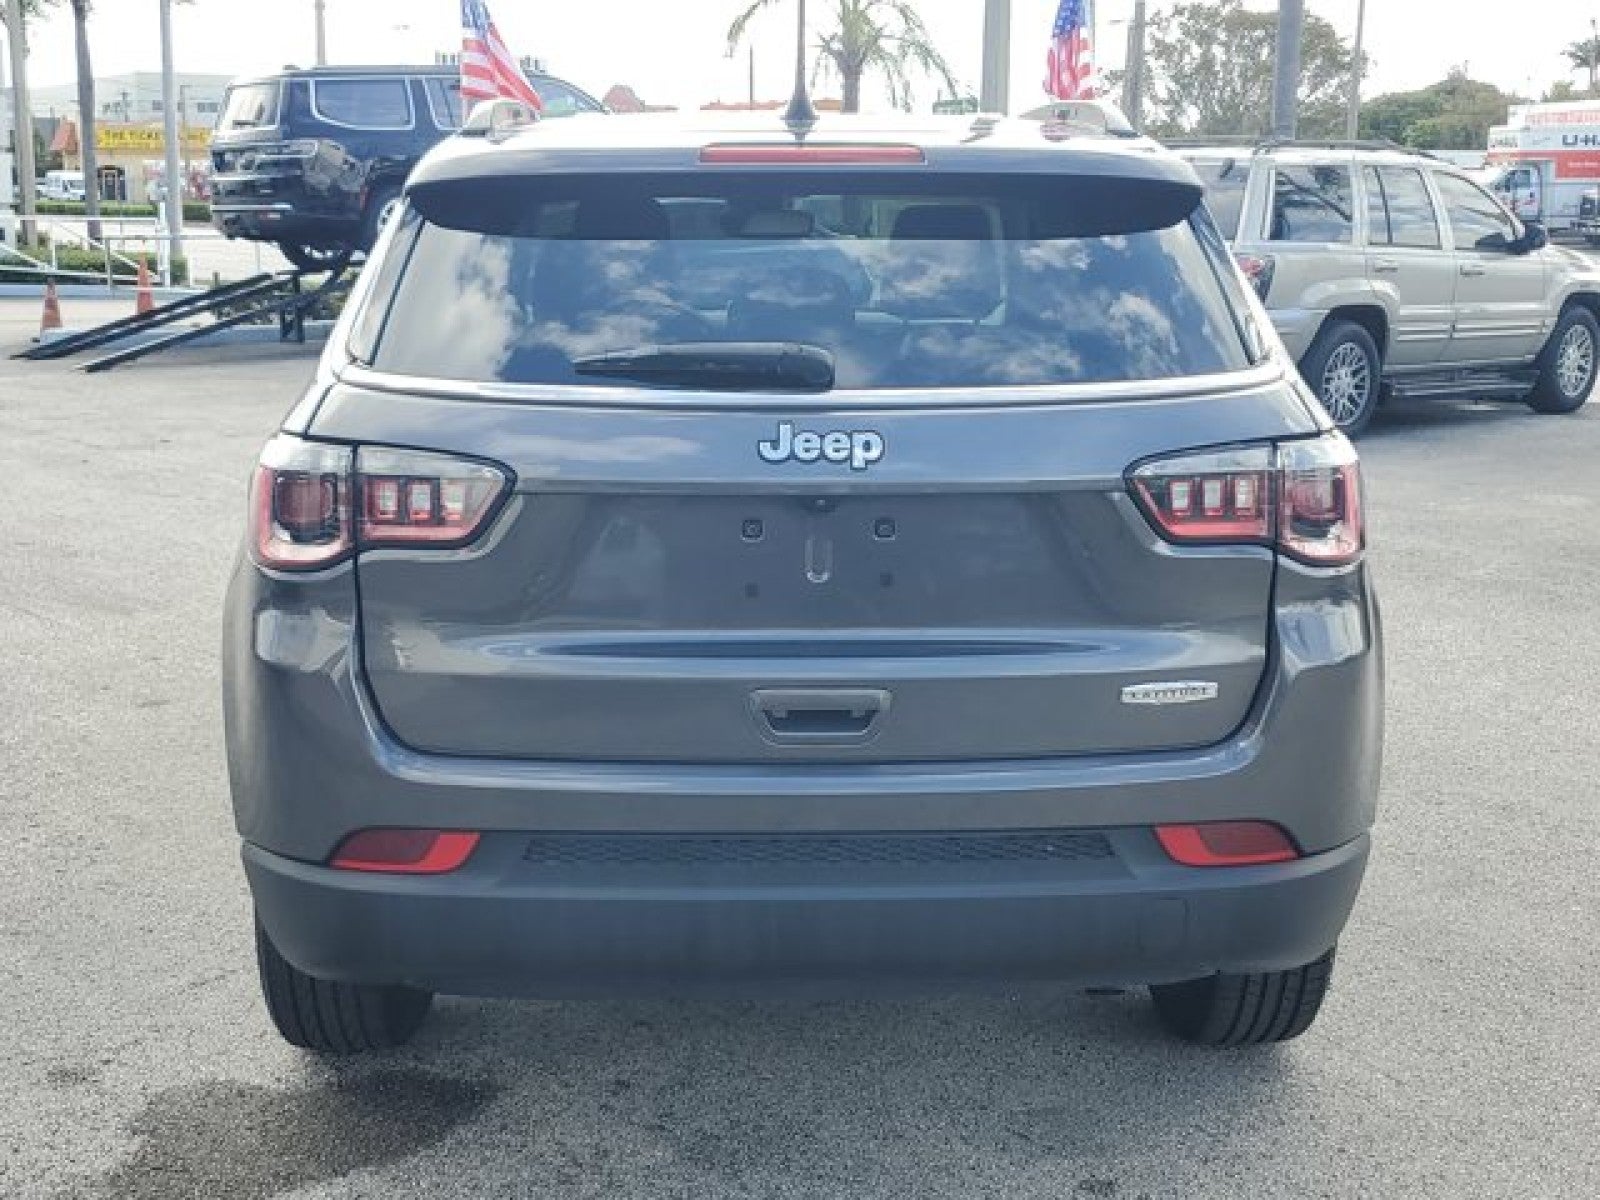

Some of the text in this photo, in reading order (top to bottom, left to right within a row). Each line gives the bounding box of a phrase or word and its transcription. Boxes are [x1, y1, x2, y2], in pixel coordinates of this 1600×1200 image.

[129, 130, 163, 141] TICKE
[1562, 134, 1600, 146] U-H
[758, 421, 885, 470] Jeep
[1128, 684, 1211, 700] LATITUDE
